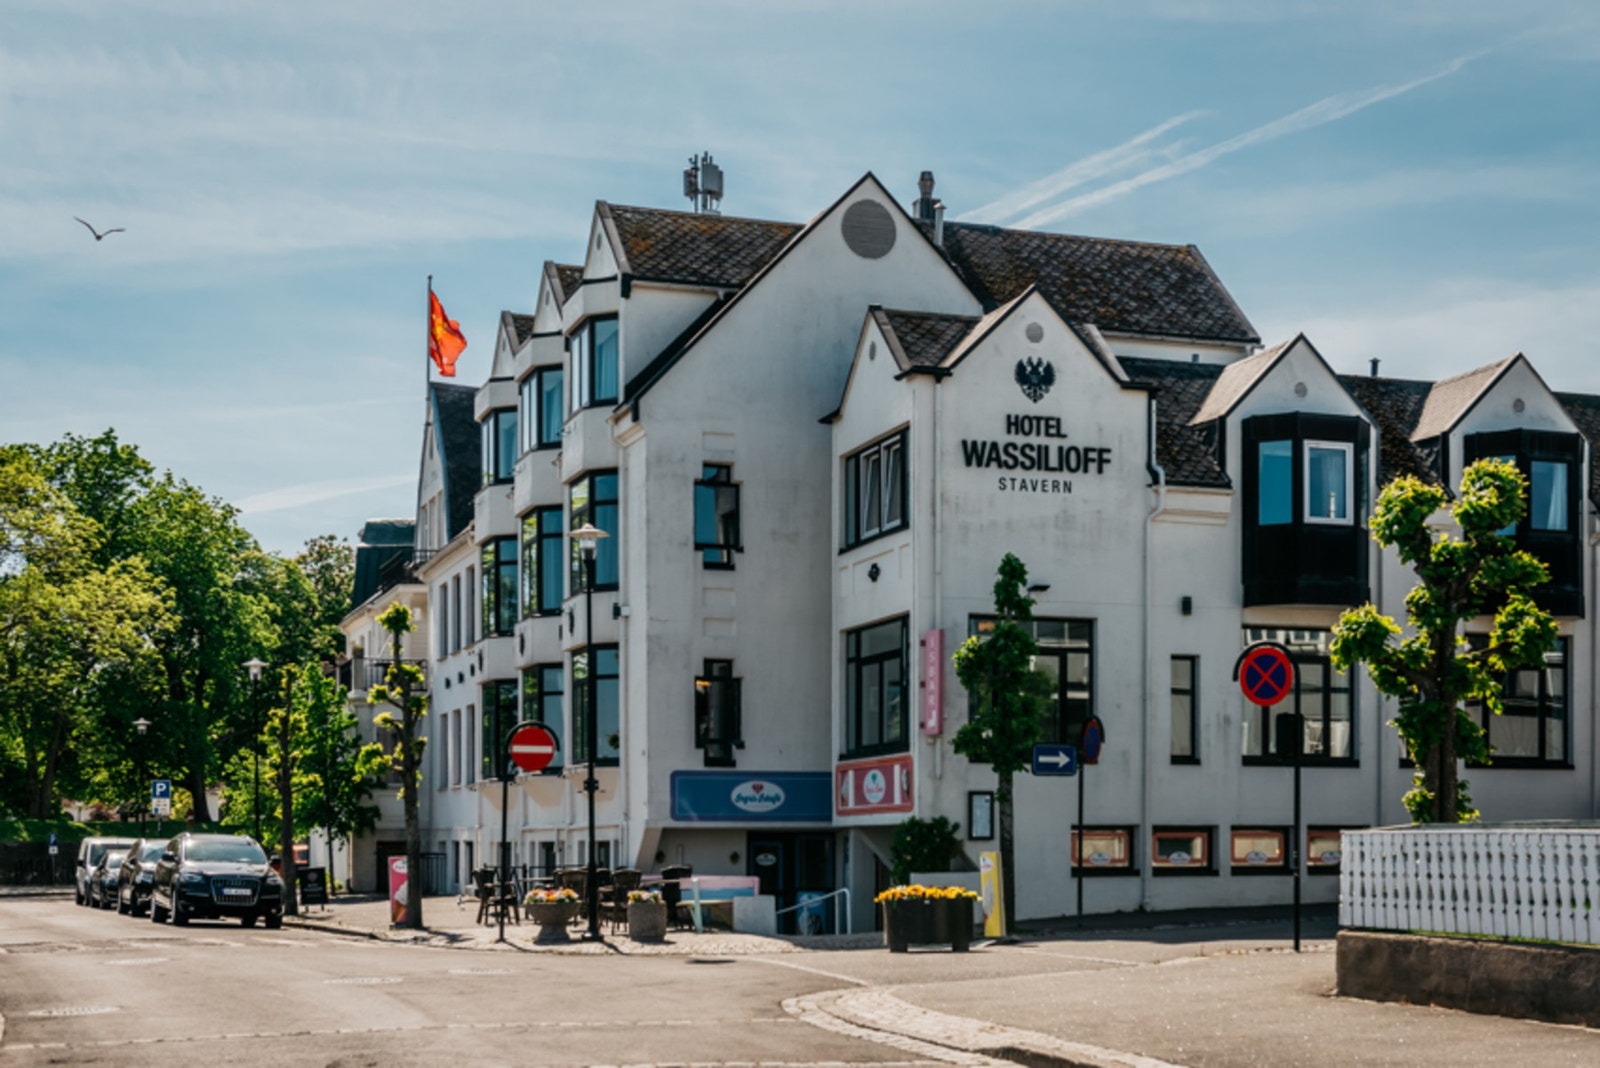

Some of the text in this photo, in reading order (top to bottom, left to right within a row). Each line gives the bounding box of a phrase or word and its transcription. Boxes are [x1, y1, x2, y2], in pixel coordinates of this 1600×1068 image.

[1006, 414, 1067, 438] HOTEL
[962, 439, 1111, 474] WASSILIOFF
[998, 477, 1072, 493] STAVERN
[156, 783, 167, 796] P
